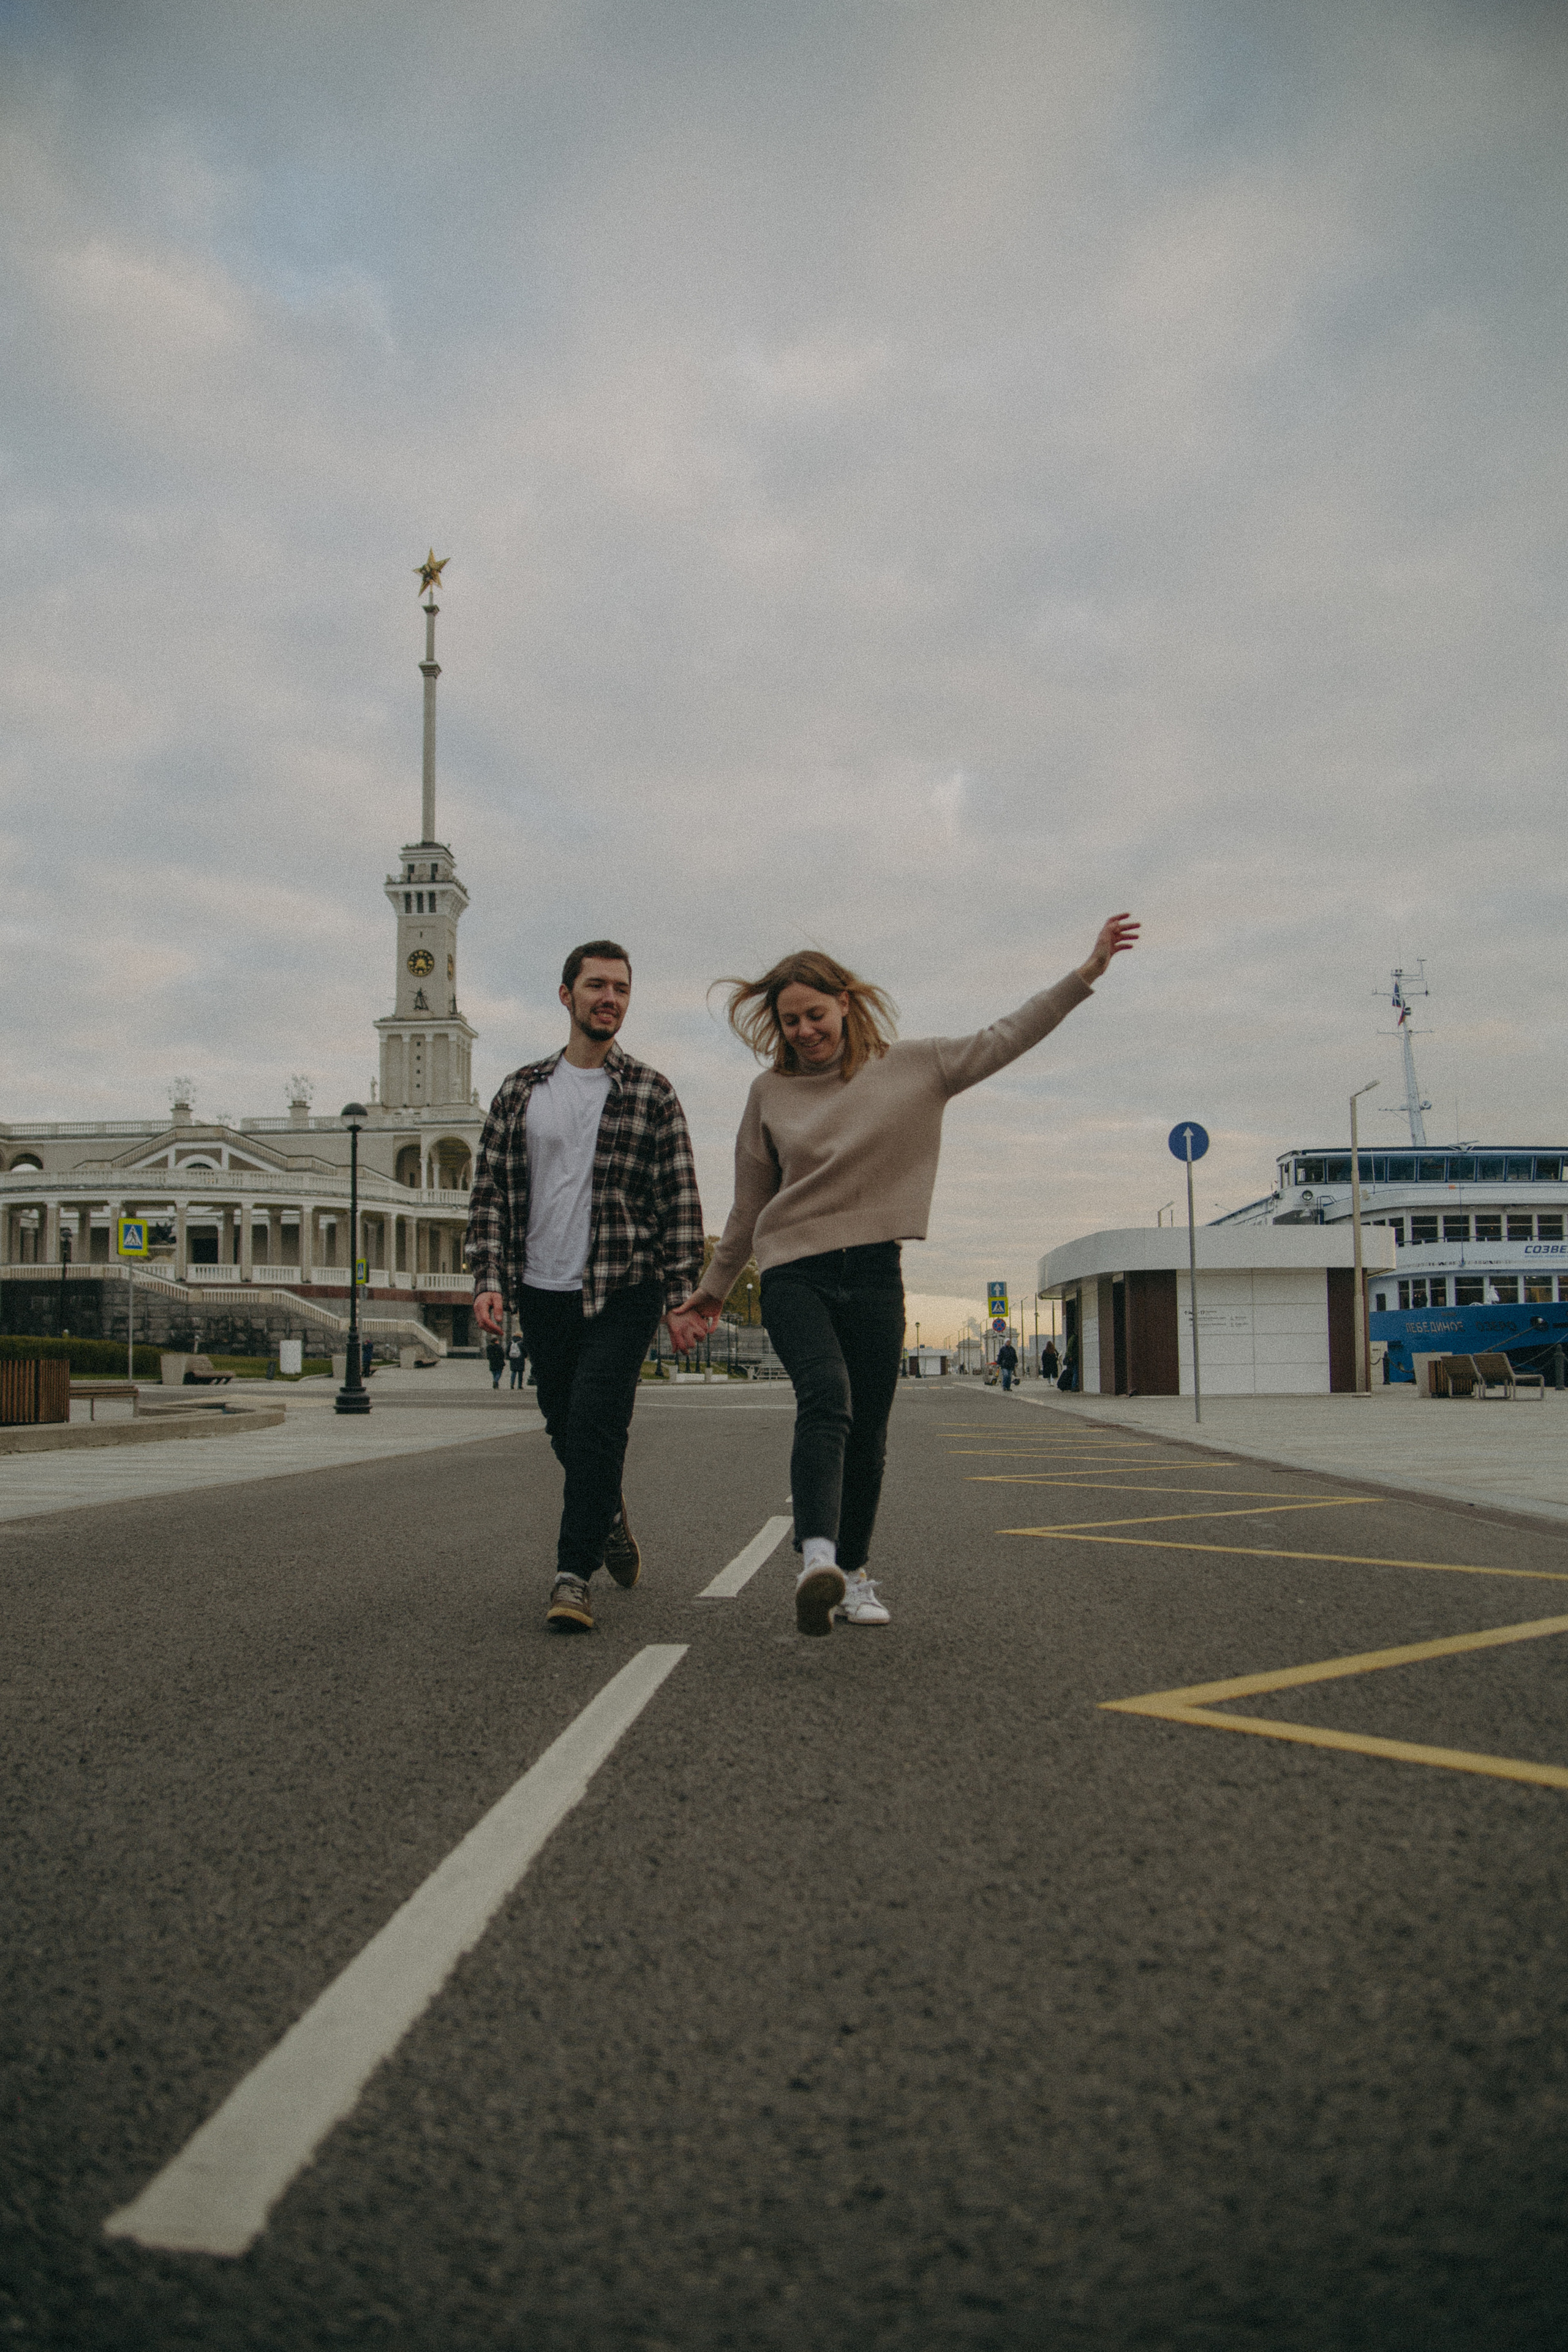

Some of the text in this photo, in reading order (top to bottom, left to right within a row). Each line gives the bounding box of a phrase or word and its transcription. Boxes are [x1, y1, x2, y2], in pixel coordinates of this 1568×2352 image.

[1525, 1245, 1568, 1254] СОЗВЕ
[1405, 1321, 1517, 1333] ЛЕБЕДИНОЕ ОЗЕРО
